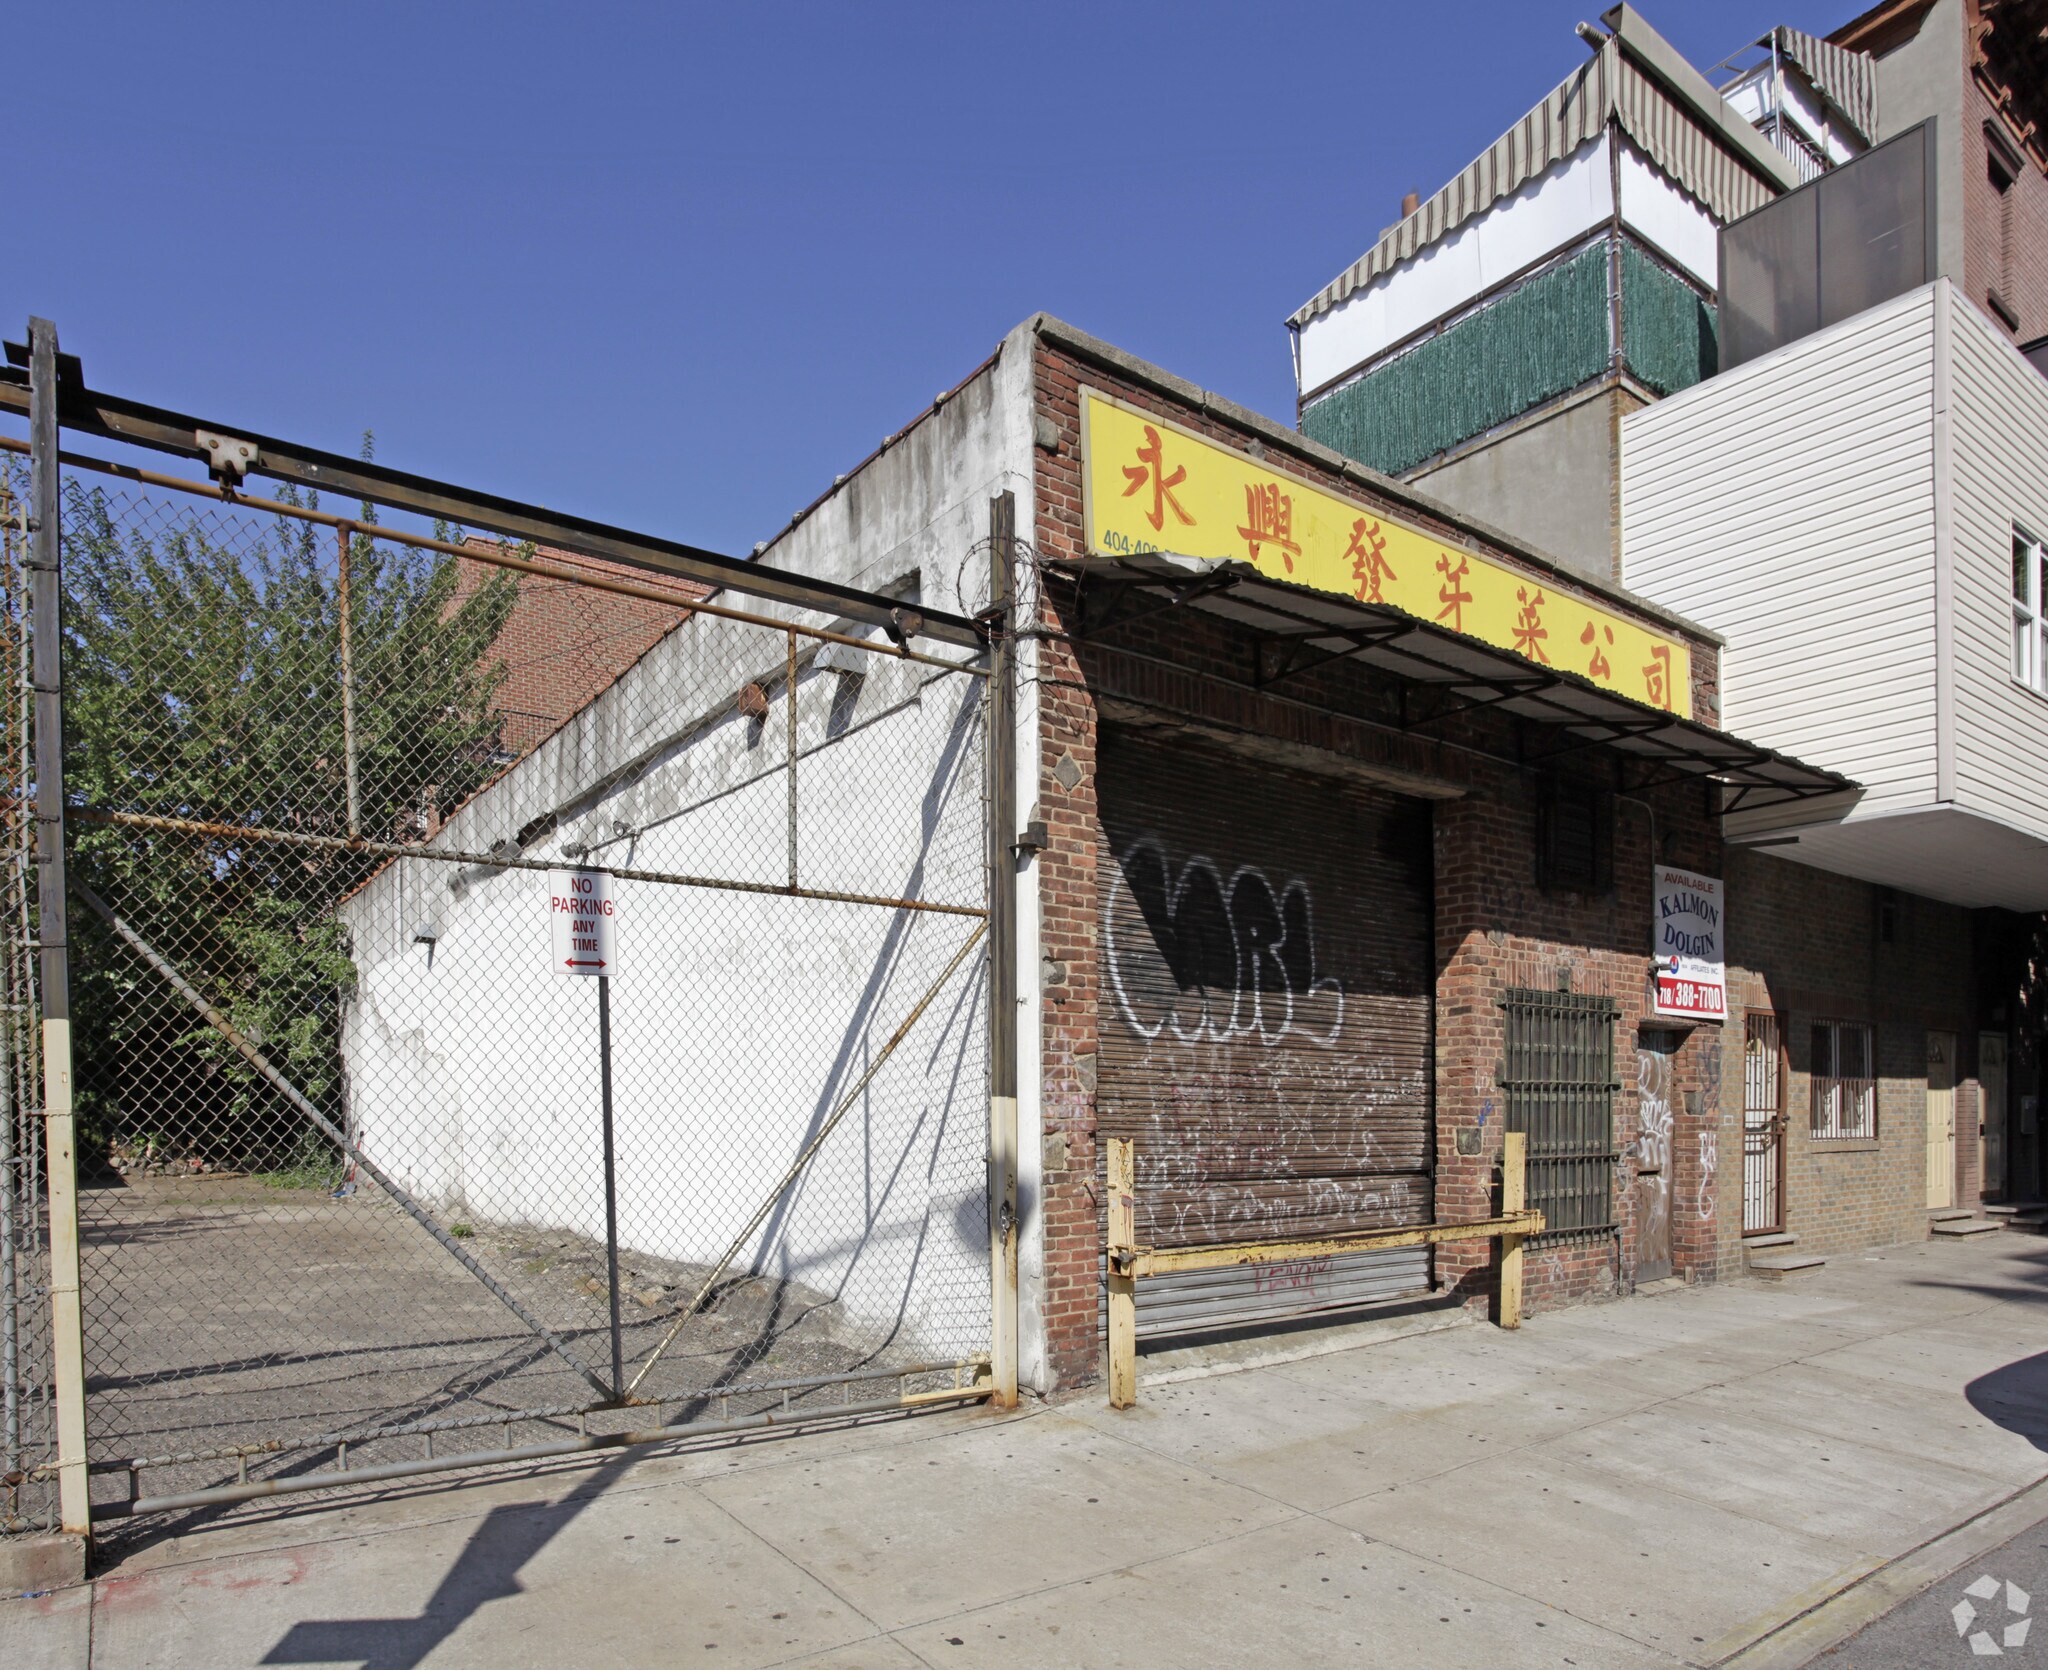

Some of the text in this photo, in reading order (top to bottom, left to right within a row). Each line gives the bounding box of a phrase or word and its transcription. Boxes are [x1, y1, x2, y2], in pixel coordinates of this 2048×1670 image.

[571, 877, 593, 894] NO
[1664, 873, 1715, 894] AVAILABLE
[552, 896, 613, 916] PARKING
[1659, 892, 1719, 928] KALMON
[572, 919, 596, 933] ANY
[571, 937, 599, 952] TIME
[1663, 922, 1715, 956] DOLGIN
[1676, 982, 1722, 1010] 388-7700
